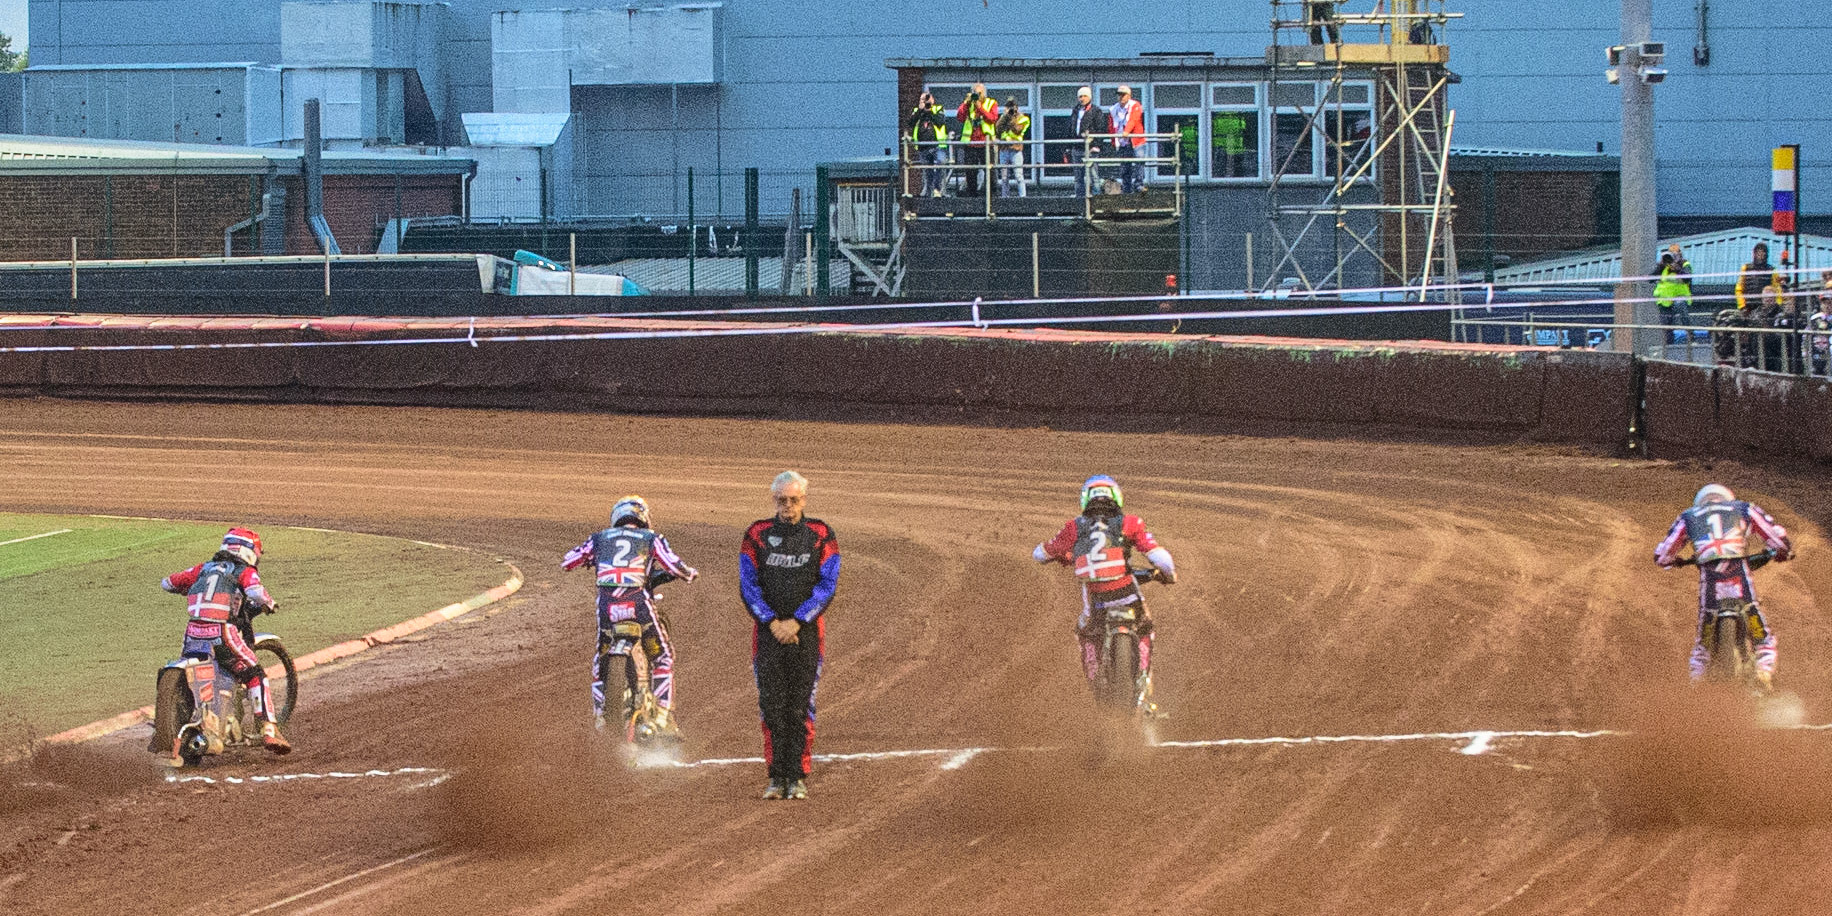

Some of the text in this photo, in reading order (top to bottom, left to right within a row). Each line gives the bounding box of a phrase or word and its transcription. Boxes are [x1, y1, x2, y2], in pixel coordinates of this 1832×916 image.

[1706, 513, 1723, 539] 1
[612, 539, 632, 566] 2
[1090, 532, 1107, 561] 2
[205, 574, 220, 601] 1
